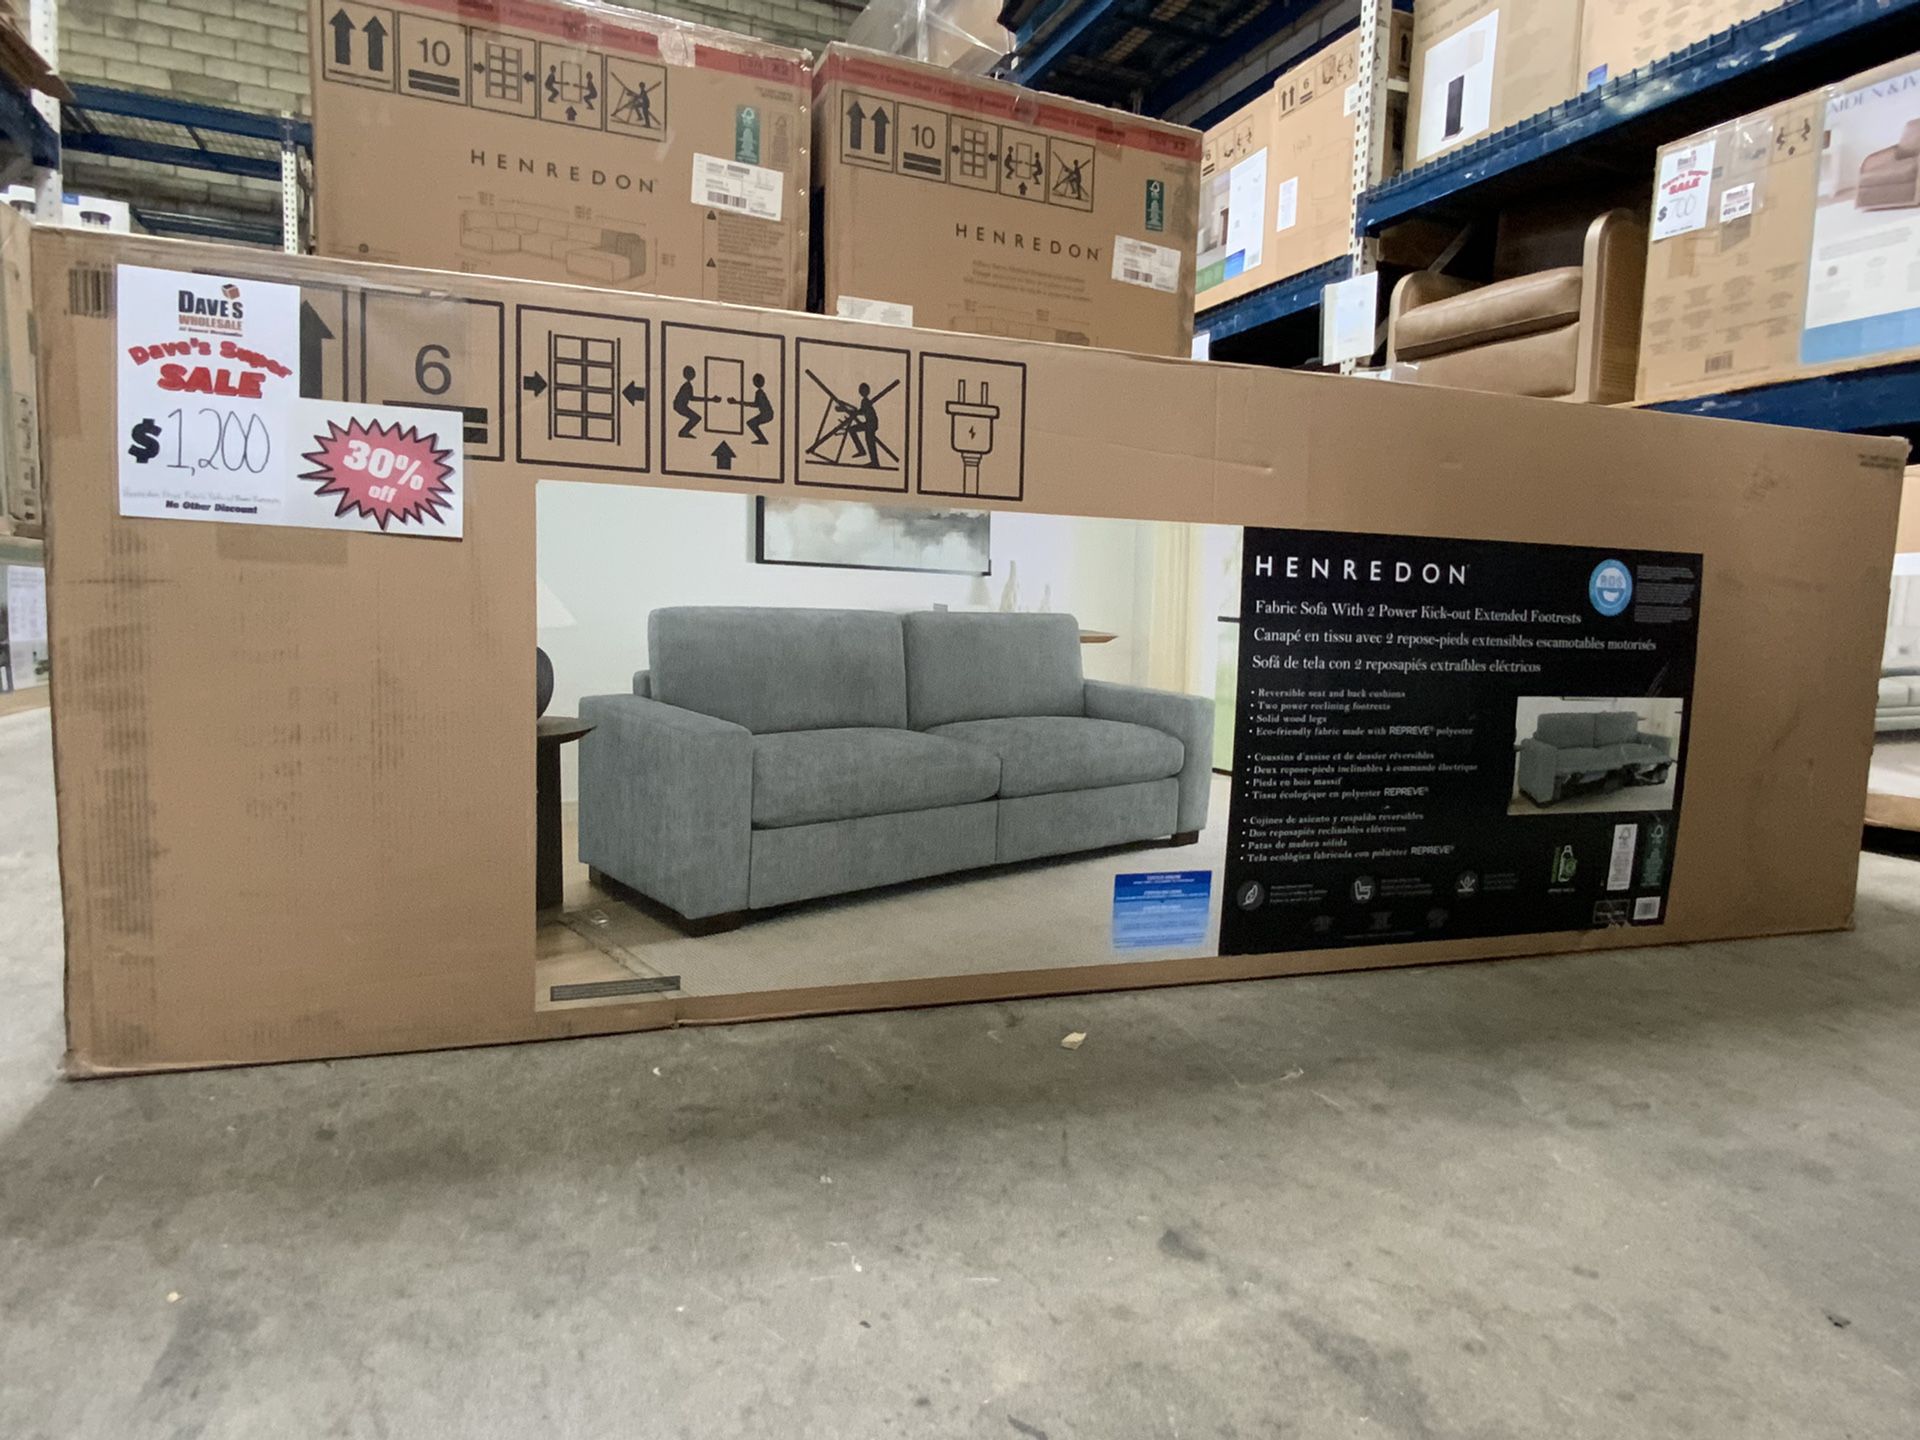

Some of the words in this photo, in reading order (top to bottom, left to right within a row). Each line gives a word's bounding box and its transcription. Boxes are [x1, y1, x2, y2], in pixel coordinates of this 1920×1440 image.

[417, 37, 451, 67] 10
[911, 123, 936, 149] 10
[470, 148, 655, 193] HENREDON
[955, 222, 1099, 261] HENREDON
[178, 314, 243, 331] WHOLESALE
[128, 337, 212, 366] Dave's
[415, 344, 452, 395] 6
[157, 363, 267, 399] SALE
[342, 439, 424, 491] 30%
[368, 485, 398, 503] off
[165, 500, 180, 509] No
[182, 501, 211, 512] Other
[214, 502, 258, 514] Discount
[1255, 555, 1466, 586] HENREDON
[1255, 600, 1297, 615] Fabric
[1300, 601, 1327, 616] Sofa
[1332, 602, 1364, 617] With
[1366, 606, 1375, 618] 2
[1378, 604, 1418, 618] Power
[1421, 605, 1471, 620] Kick-out
[1474, 607, 1528, 622] Extended
[1530, 609, 1582, 624] Footrests
[1253, 628, 1302, 645] Canapé
[1304, 632, 1319, 642] en
[1323, 629, 1352, 643] tissu
[1355, 632, 1382, 644] avec
[1385, 632, 1394, 644] 2
[1397, 632, 1469, 649] repose-pieds
[1472, 634, 1533, 648] extensibles
[1536, 636, 1605, 650] escamotables
[1607, 638, 1657, 651] motorisés
[1252, 654, 1280, 669] Sofá
[1283, 655, 1299, 669] de
[1302, 655, 1325, 669] tela
[1328, 658, 1351, 670] con
[1354, 658, 1362, 670] 2
[1365, 657, 1427, 675] reposapiés
[1489, 659, 1541, 673] eléctricos
[1258, 688, 1306, 698] Reversible
[1328, 689, 1345, 698] and
[1257, 700, 1278, 710] Two
[1280, 703, 1308, 713] power
[1310, 701, 1350, 713] reclining
[1256, 714, 1280, 723] Solid
[1256, 726, 1312, 738] Eco-friendly
[1254, 752, 1295, 762] Coussins
[1253, 765, 1277, 774] Deux
[1252, 778, 1277, 787] Pieds
[1252, 790, 1277, 800] Tissu
